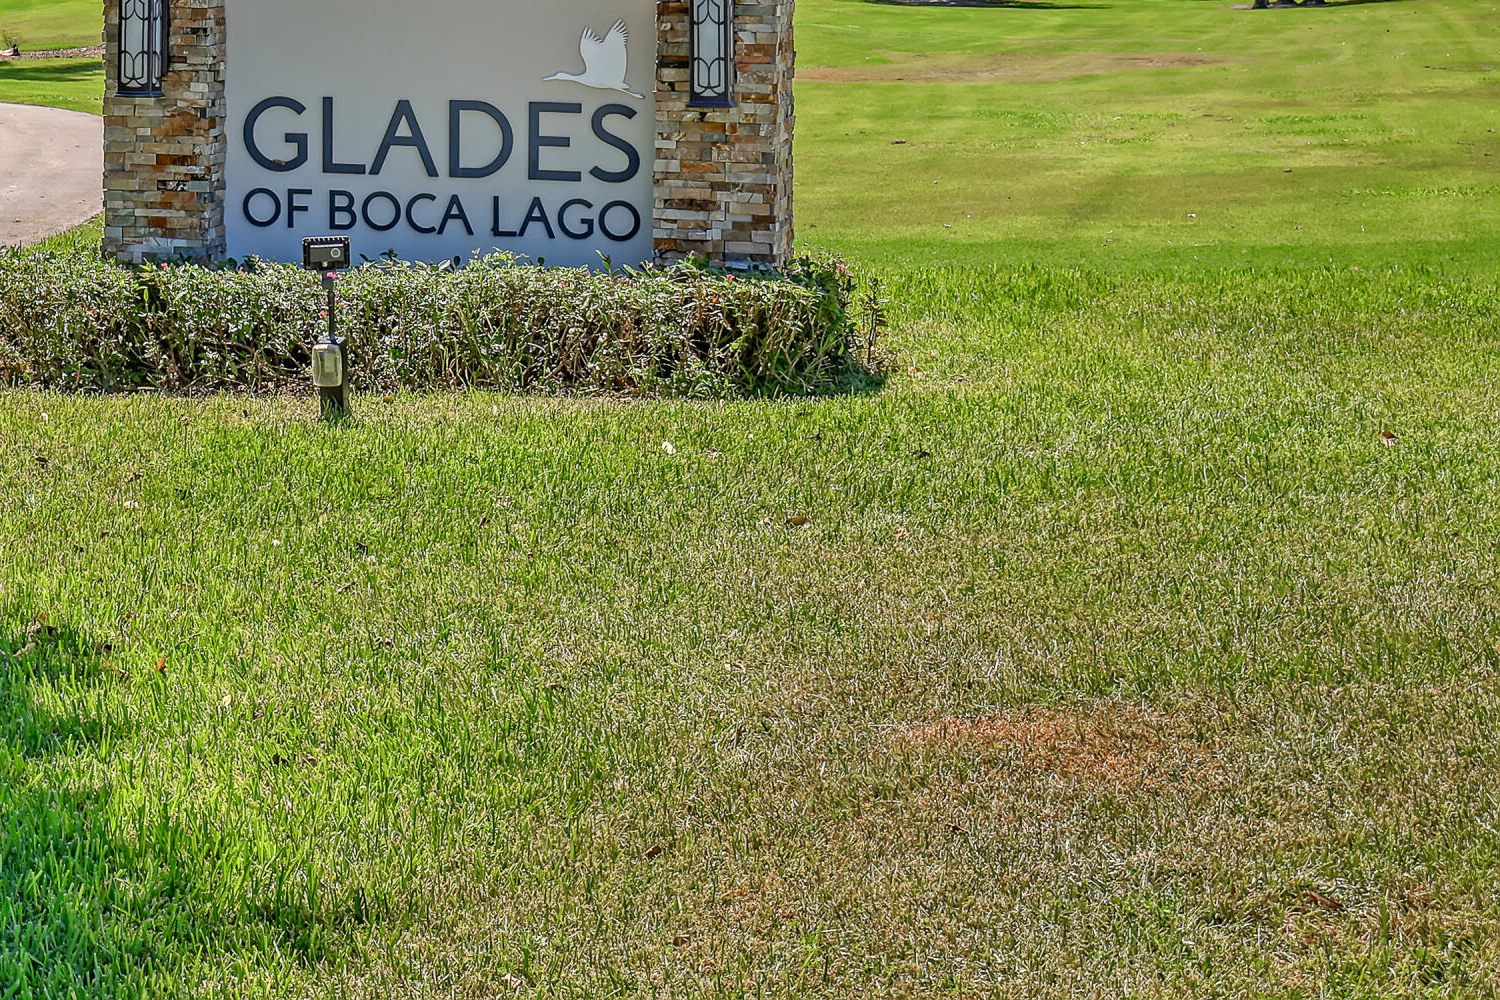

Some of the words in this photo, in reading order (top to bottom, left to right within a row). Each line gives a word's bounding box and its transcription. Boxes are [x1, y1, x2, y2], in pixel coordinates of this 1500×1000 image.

[242, 96, 641, 184] GLADES
[242, 187, 313, 229] OF
[328, 189, 475, 237] BOCA
[490, 195, 642, 243] LAGO
